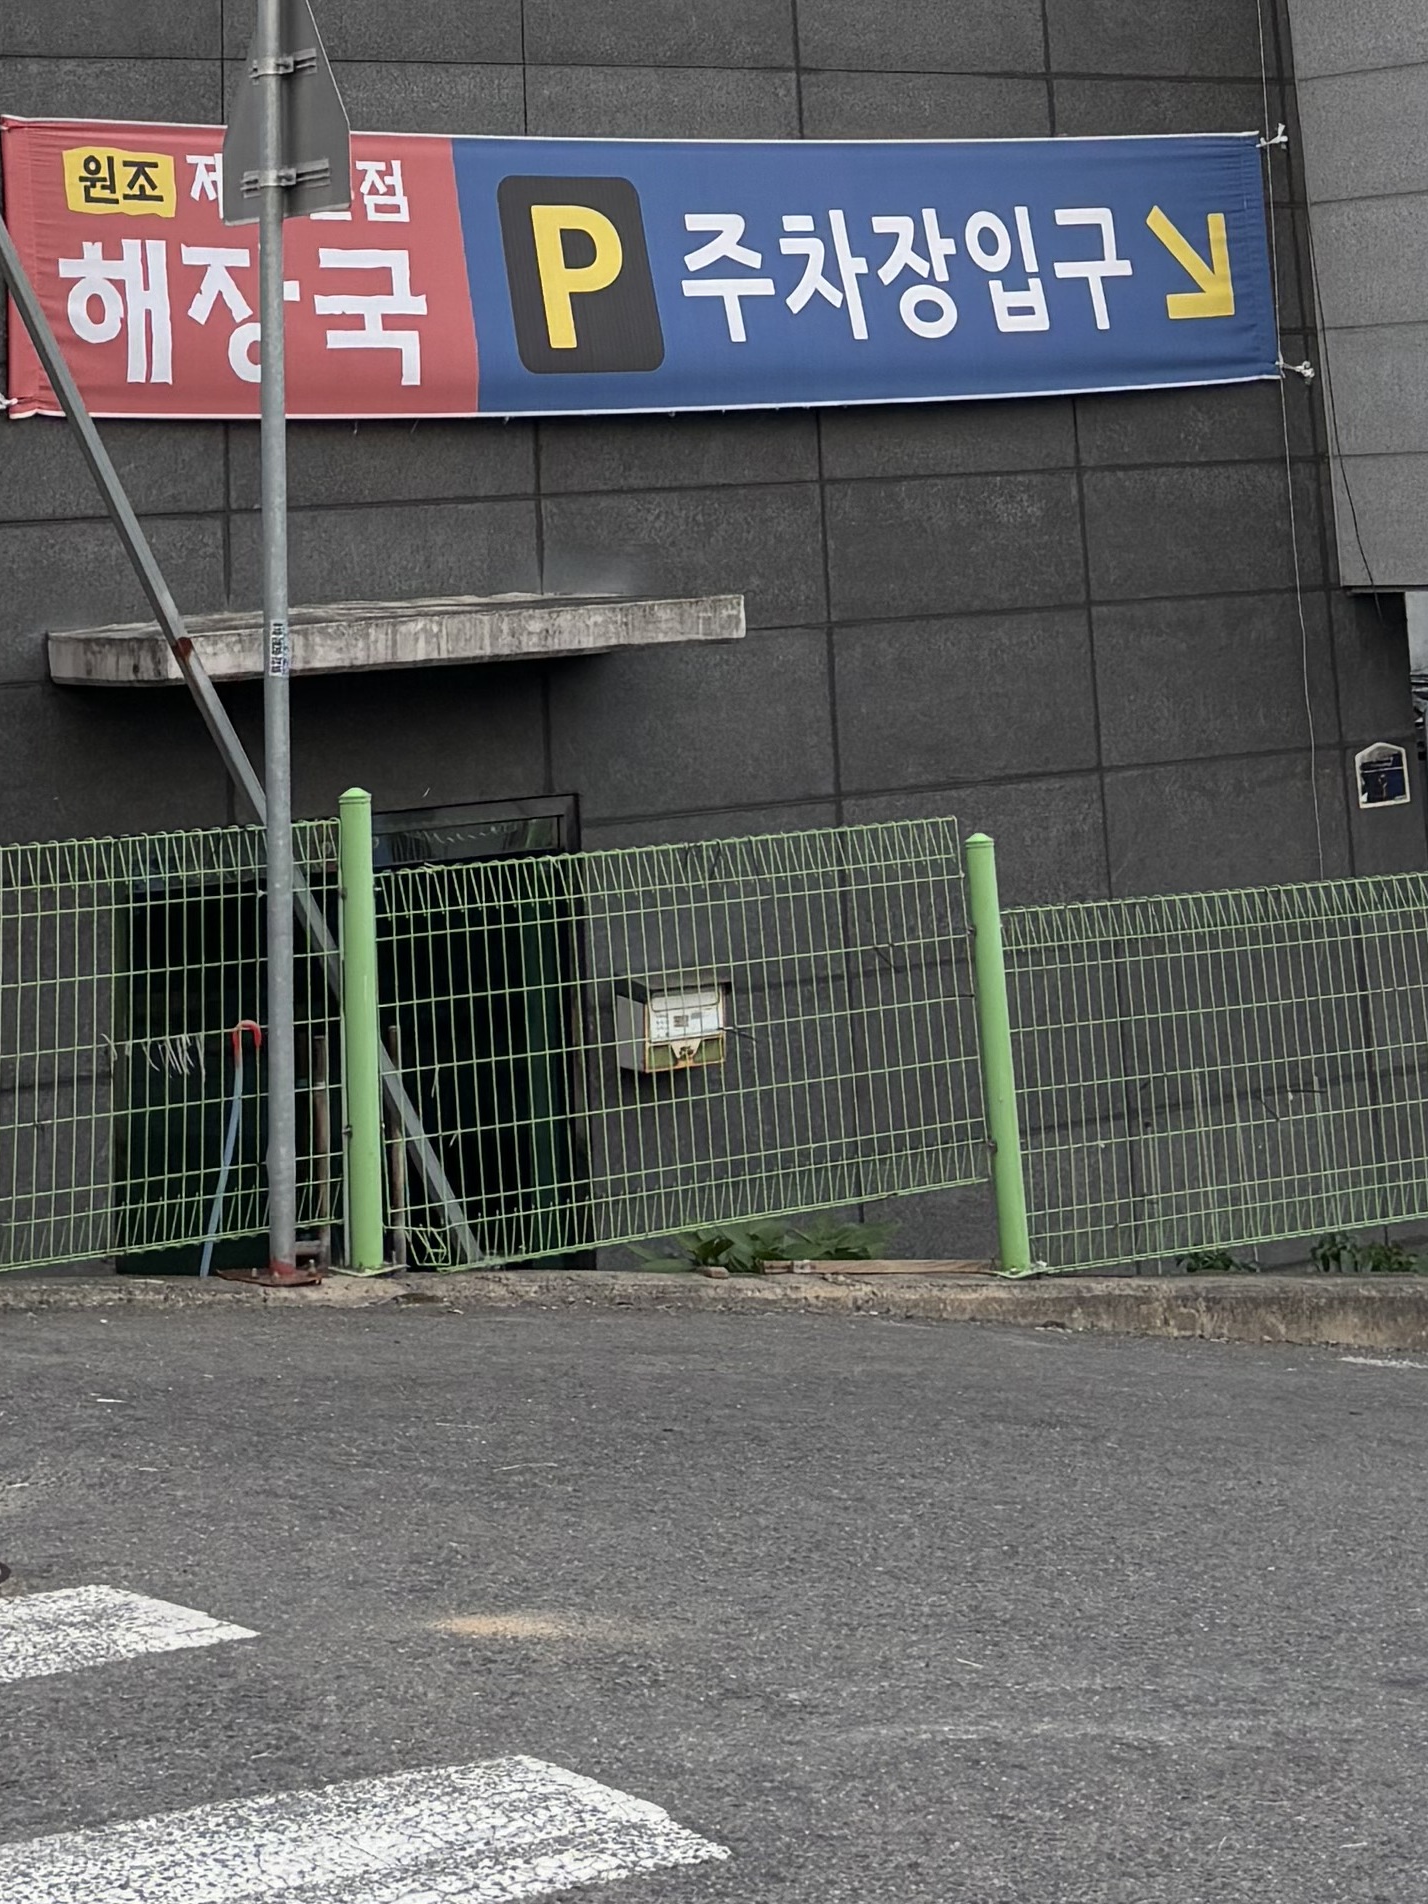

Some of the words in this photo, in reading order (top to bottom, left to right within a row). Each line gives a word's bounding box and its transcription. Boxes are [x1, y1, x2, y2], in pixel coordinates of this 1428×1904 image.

[77, 153, 165, 205] 원조
[57, 238, 429, 387] 해장국
[530, 203, 624, 350] P
[681, 204, 1135, 344] 주차장입구
